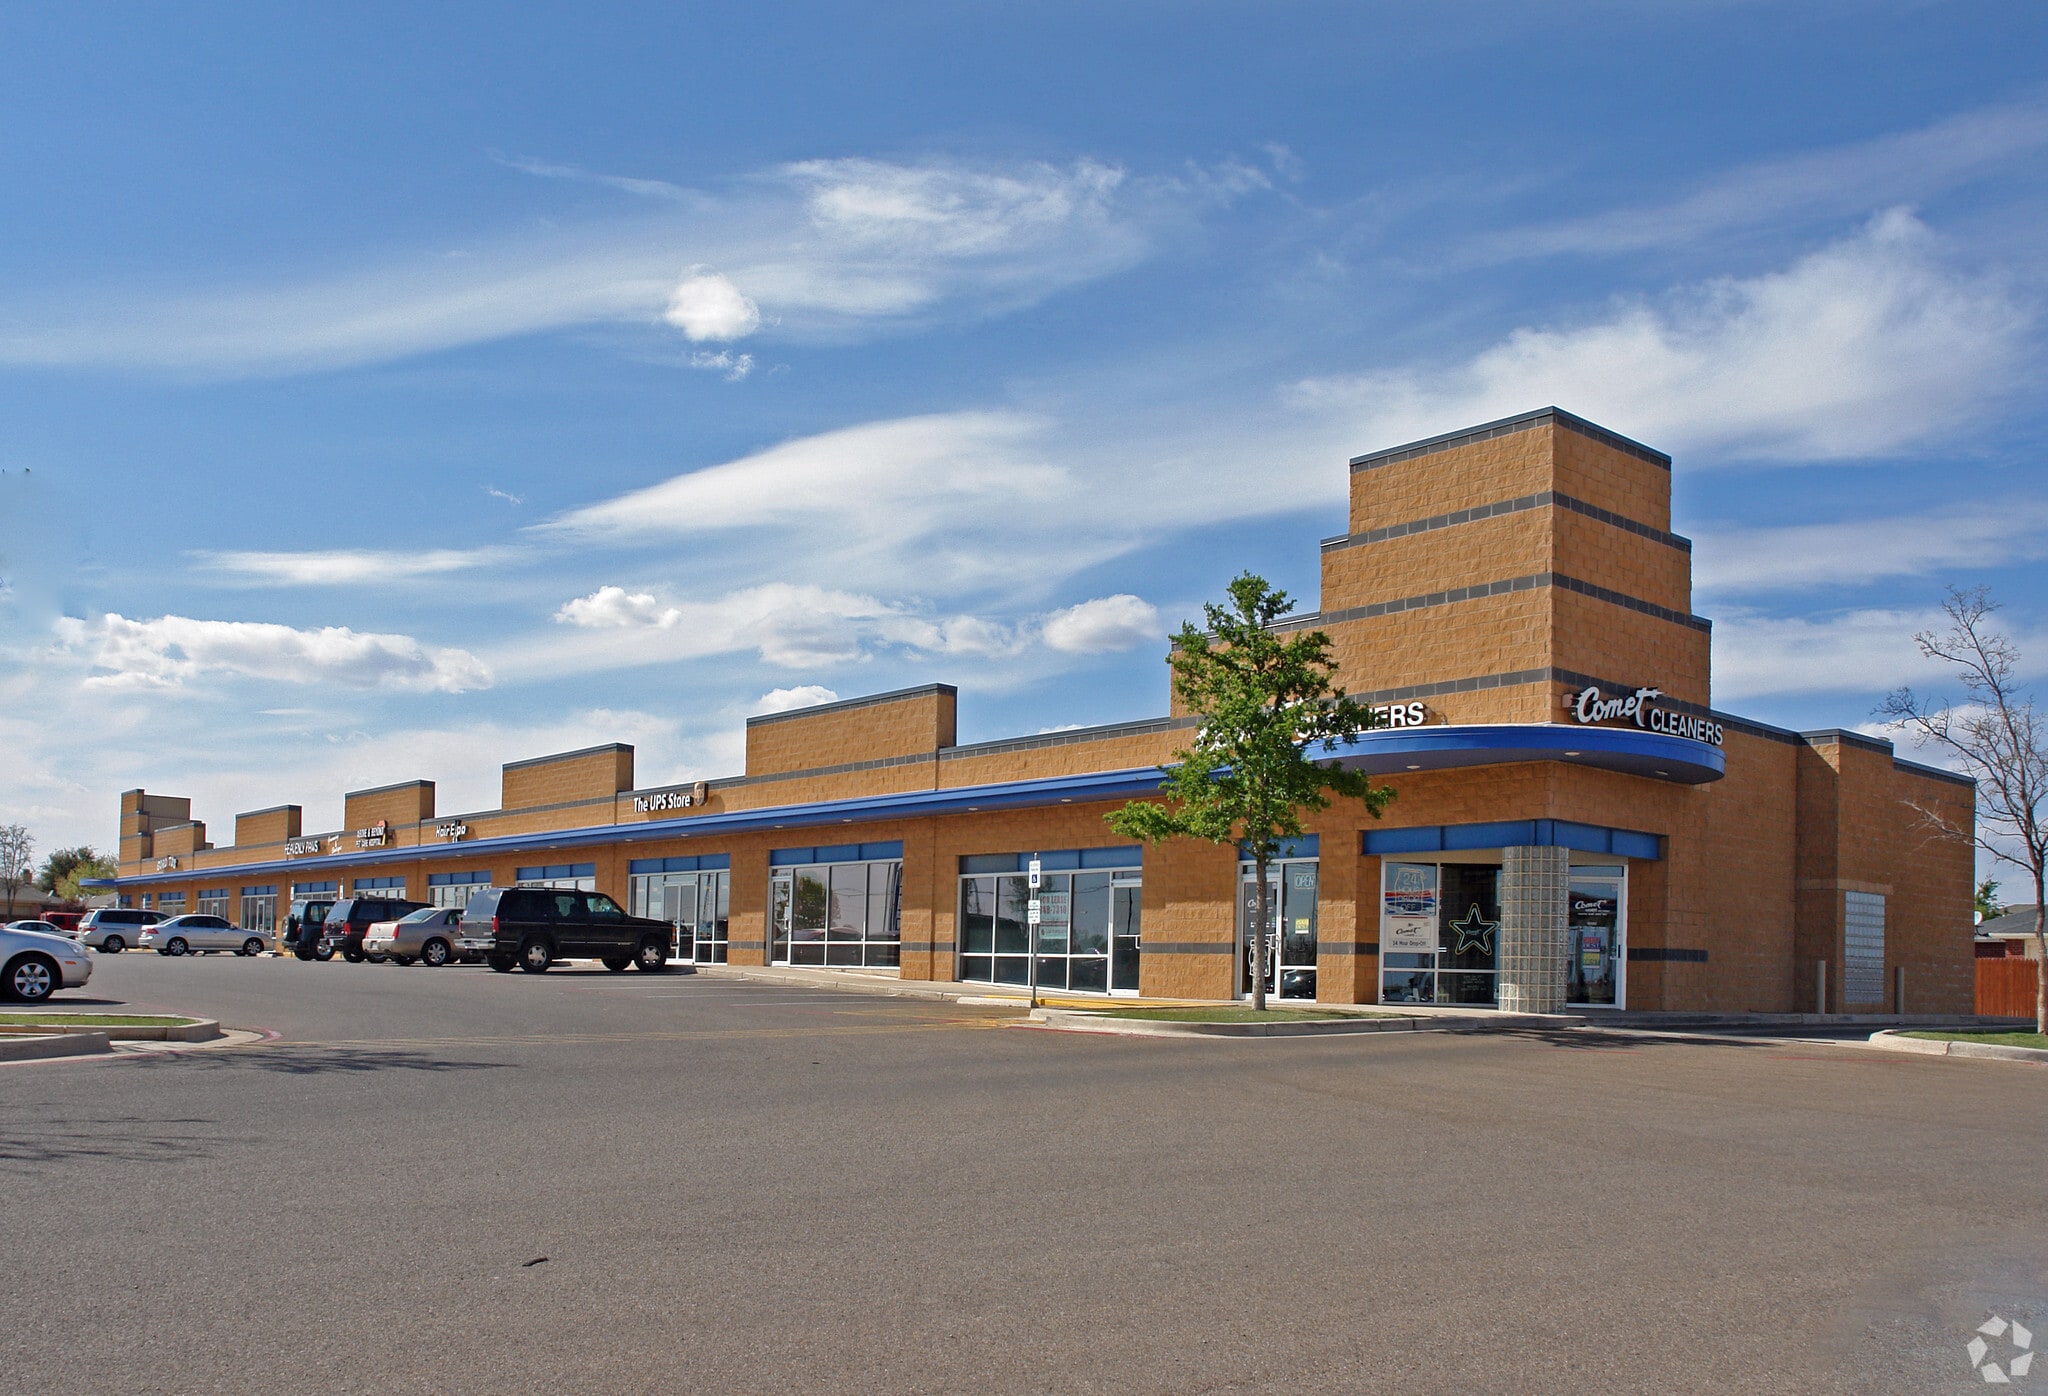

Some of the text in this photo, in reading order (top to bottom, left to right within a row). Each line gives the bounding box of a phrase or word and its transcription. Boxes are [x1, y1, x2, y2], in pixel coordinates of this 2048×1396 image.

[1573, 686, 1664, 727] Comet
[1650, 708, 1724, 746] CLEANERS
[634, 796, 649, 813] The
[650, 793, 667, 811] UPS
[668, 792, 691, 809] Store
[436, 824, 450, 837] Hair
[1295, 875, 1314, 888] OPEN
[1575, 900, 1607, 909] Comet
